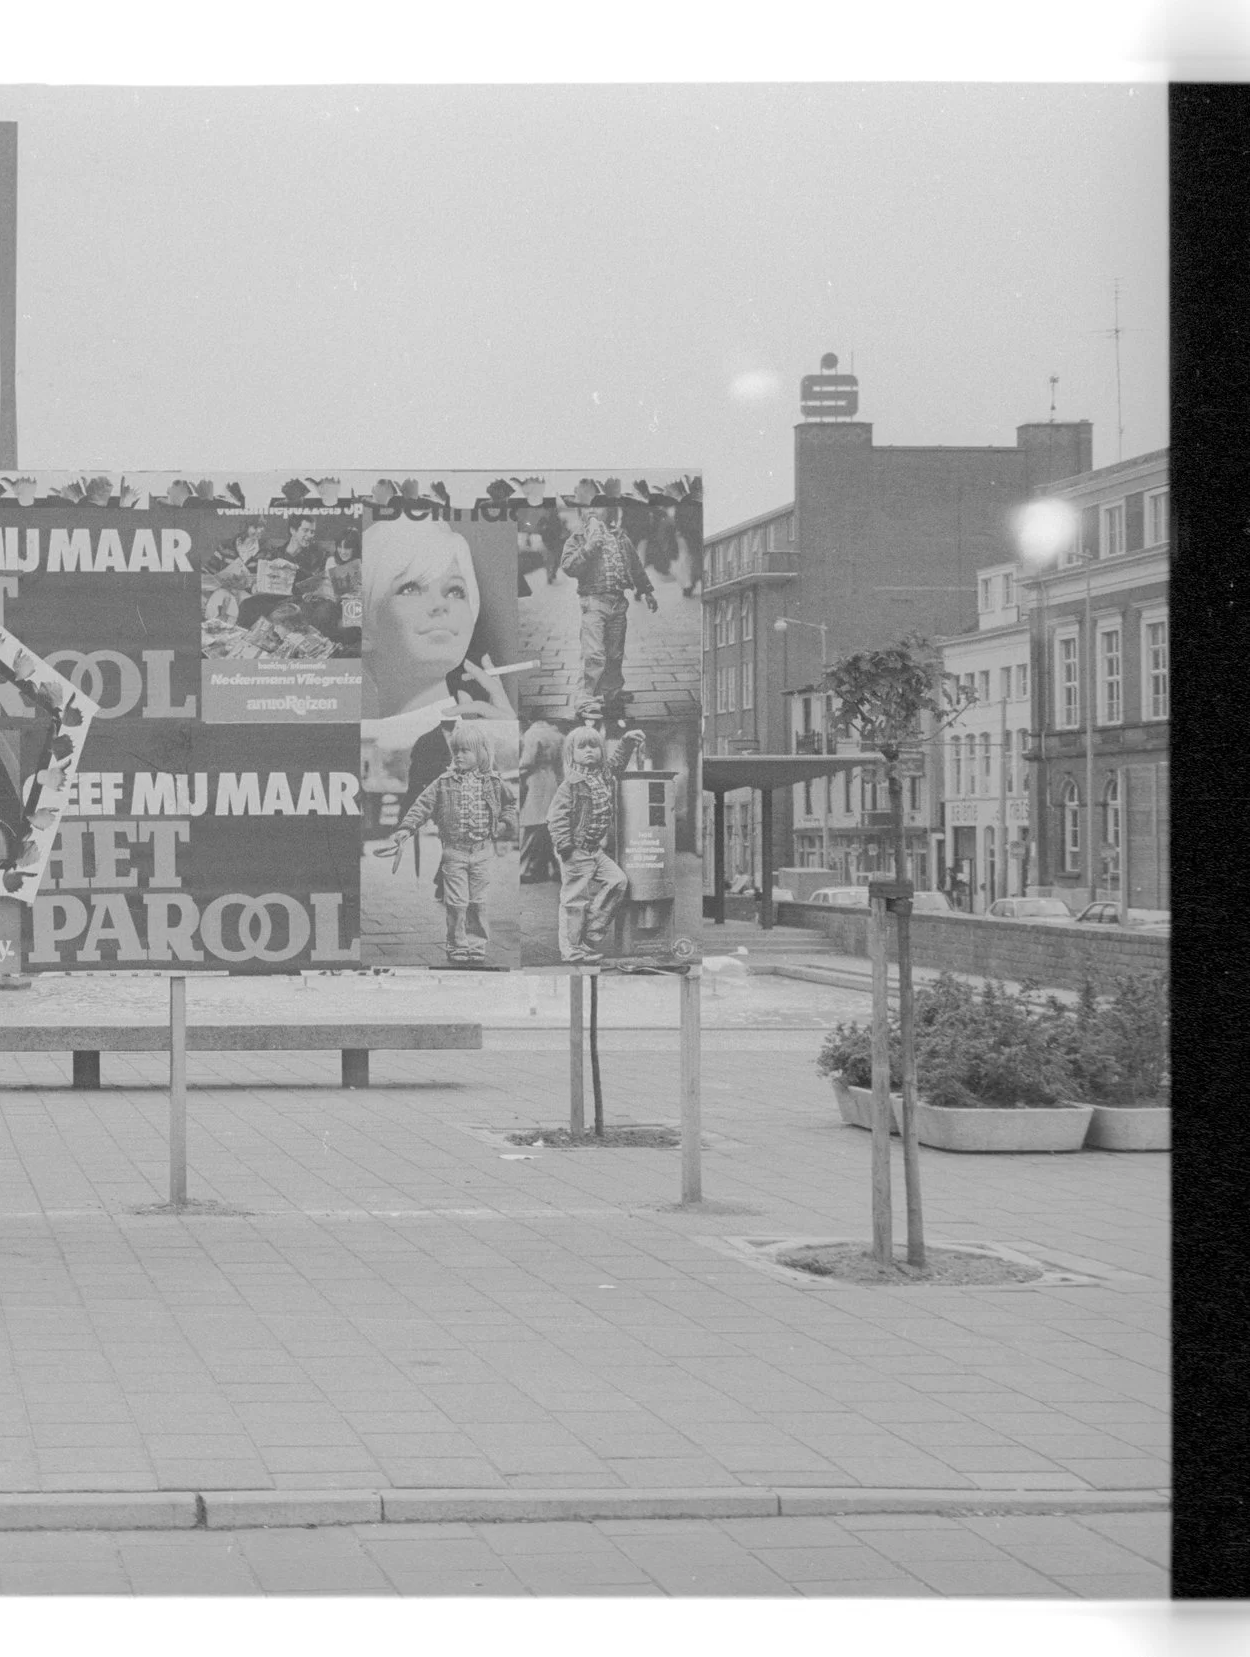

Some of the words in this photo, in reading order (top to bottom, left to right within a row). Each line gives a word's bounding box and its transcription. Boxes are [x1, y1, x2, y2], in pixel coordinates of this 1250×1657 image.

[46, 528, 194, 572] MAAR
[211, 673, 295, 685] Neckermann
[215, 772, 363, 816] MAAR
[28, 892, 360, 962] PAROOL
